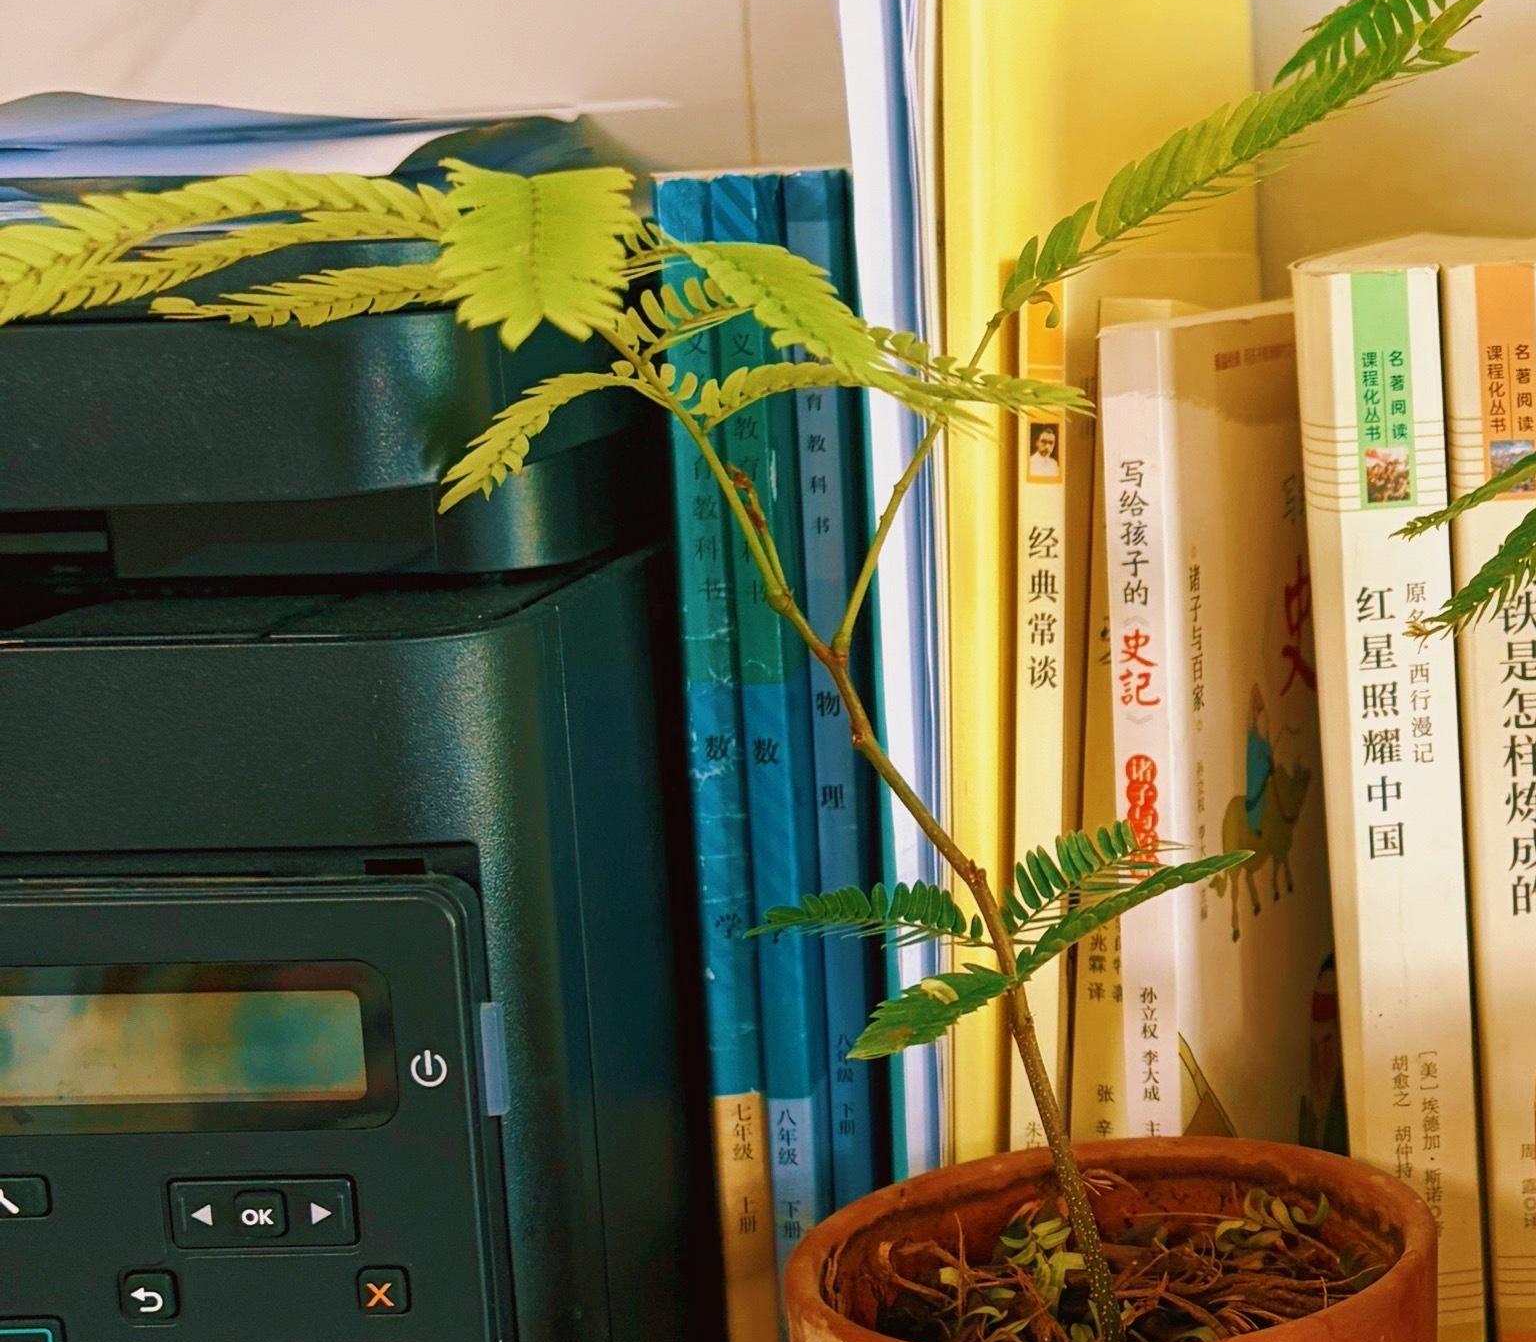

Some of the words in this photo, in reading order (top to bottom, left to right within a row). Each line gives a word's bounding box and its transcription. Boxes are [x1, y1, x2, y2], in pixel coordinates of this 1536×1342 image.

[1361, 351, 1381, 442] 课程化丛书
[1388, 350, 1408, 442] 名著阅读
[1486, 345, 1506, 434] 课程化丛书
[1513, 343, 1534, 434] 名著阅读
[1028, 526, 1060, 690] 经典常谈
[816, 690, 844, 810] 物理
[1356, 587, 1405, 860] 红星照耀中国
[1140, 986, 1159, 1040] 孙立权
[1142, 1050, 1161, 1102] 李大成
[1392, 1055, 1411, 1107] 胡愈之
[731, 1103, 753, 1161] 七年级
[778, 1108, 798, 1167] 八年级
[241, 1208, 273, 1226] OK
[739, 1196, 757, 1234] 上册
[781, 1200, 801, 1239] 下册
